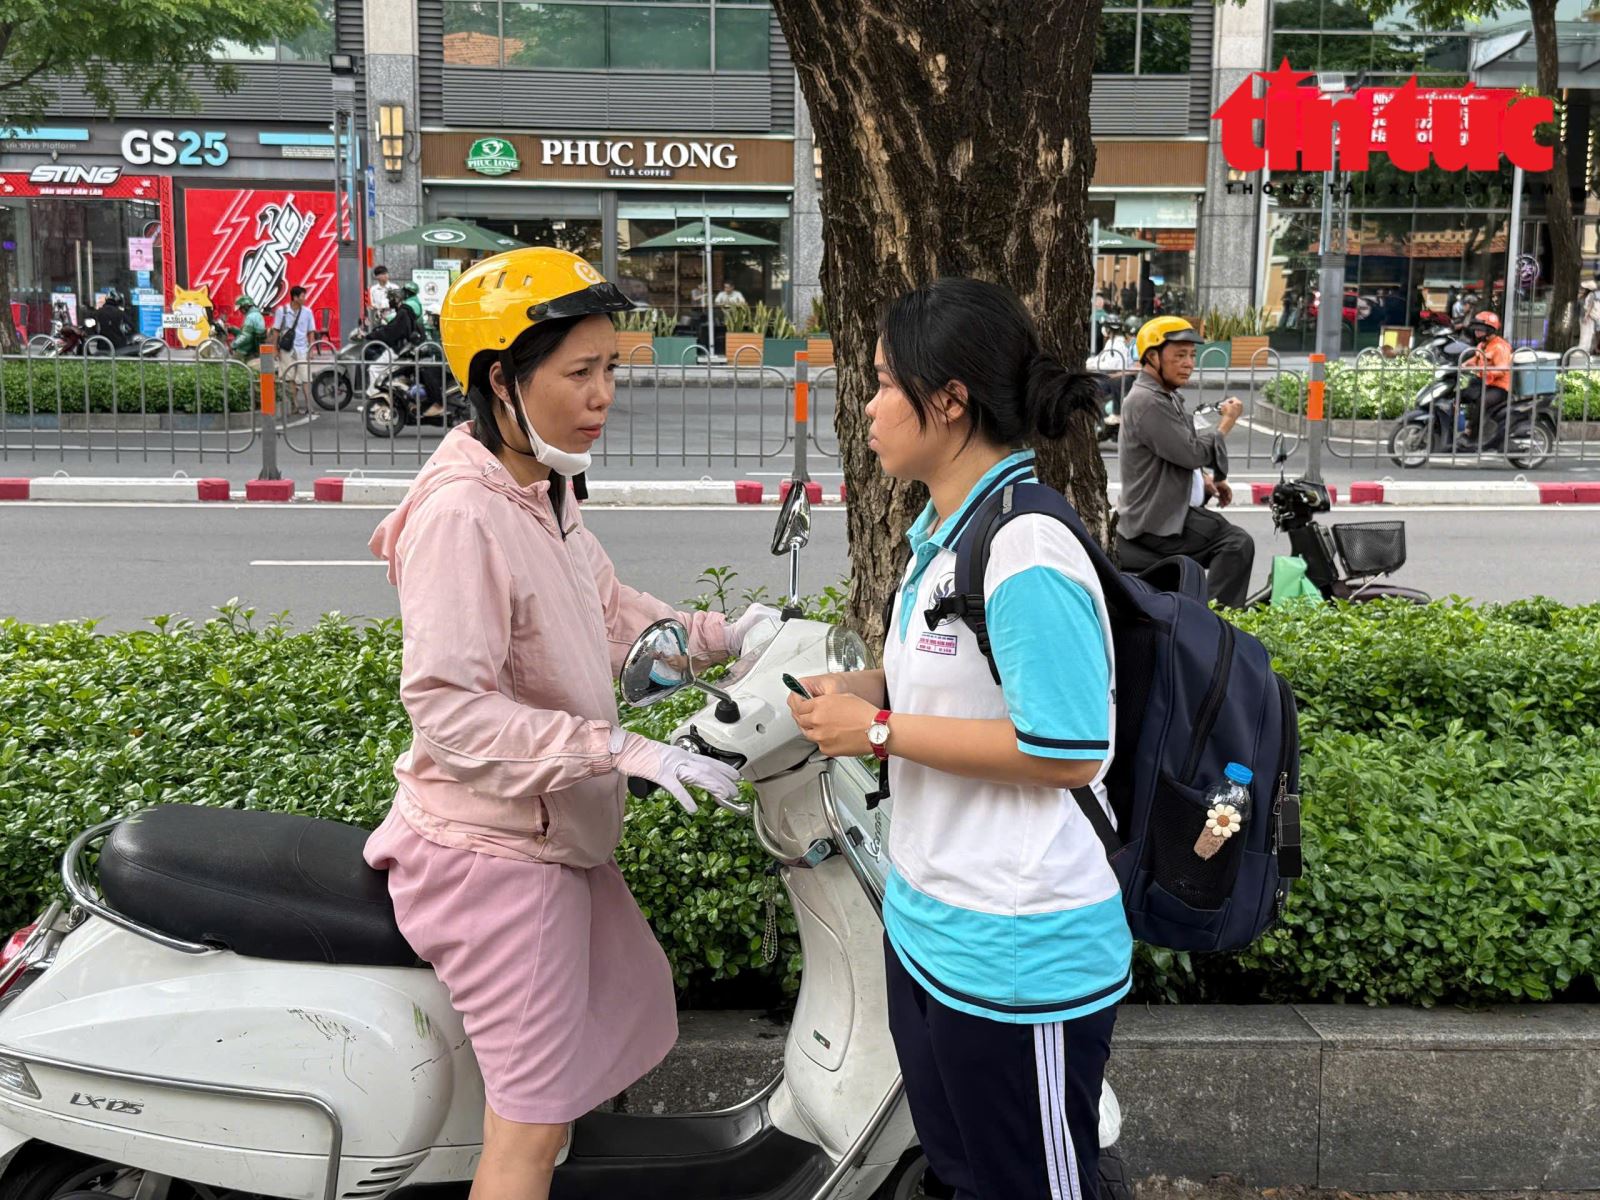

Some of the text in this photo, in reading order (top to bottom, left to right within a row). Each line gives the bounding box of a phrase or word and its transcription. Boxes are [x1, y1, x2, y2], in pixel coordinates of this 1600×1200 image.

[121, 128, 230, 167] GS25
[541, 139, 738, 169] PHUC LONG
[494, 160, 518, 168] LONG
[610, 168, 625, 176] TEA
[638, 168, 671, 176] COFFEE
[29, 165, 121, 183] STING
[245, 205, 301, 308] STING
[105, 1099, 144, 1115] 125
